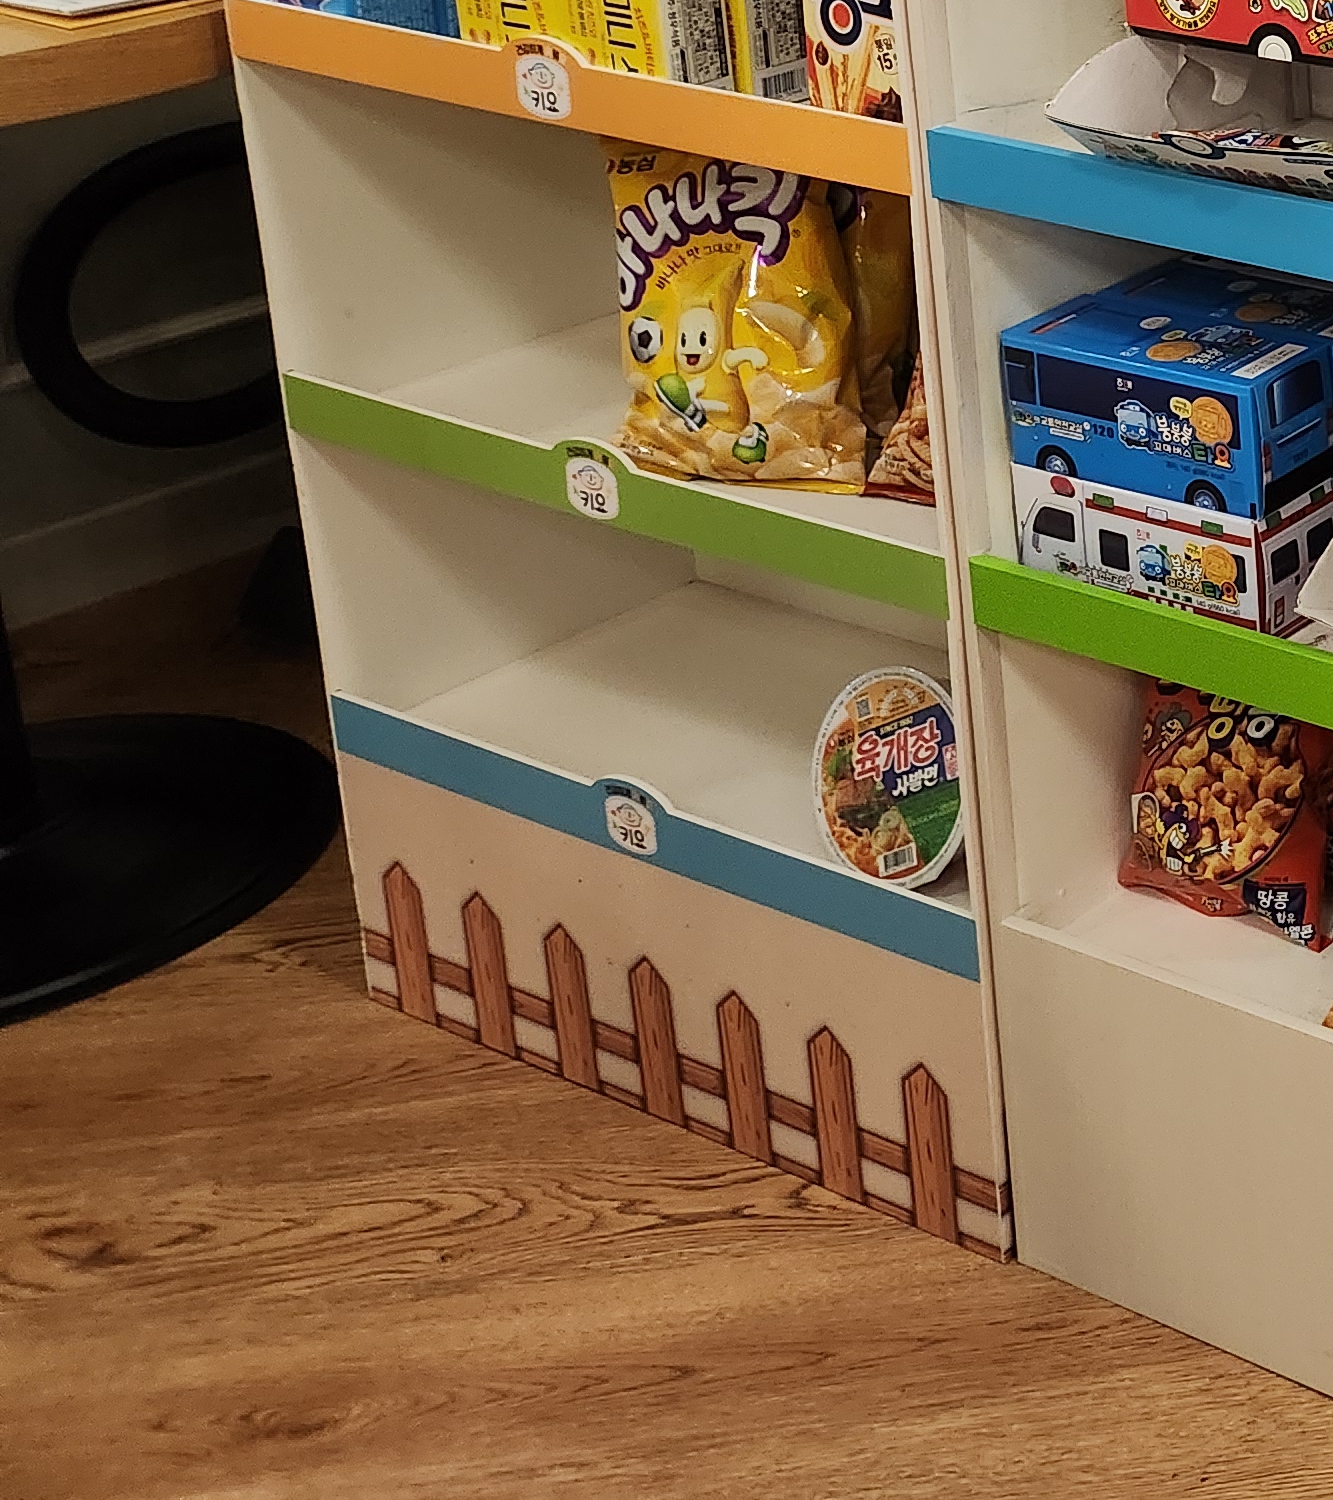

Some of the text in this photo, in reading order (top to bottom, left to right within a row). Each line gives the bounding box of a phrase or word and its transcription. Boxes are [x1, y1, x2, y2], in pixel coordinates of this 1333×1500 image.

[531, 89, 560, 113] 키요
[616, 153, 657, 175] 농심
[1091, 423, 1114, 439] 120
[1155, 415, 1193, 447] 붕붕붕
[580, 490, 607, 515] 키요
[854, 718, 943, 782] 육개장
[891, 763, 940, 798] 사발면
[617, 823, 646, 850] 키요
[1257, 889, 1290, 911] 땅콩
